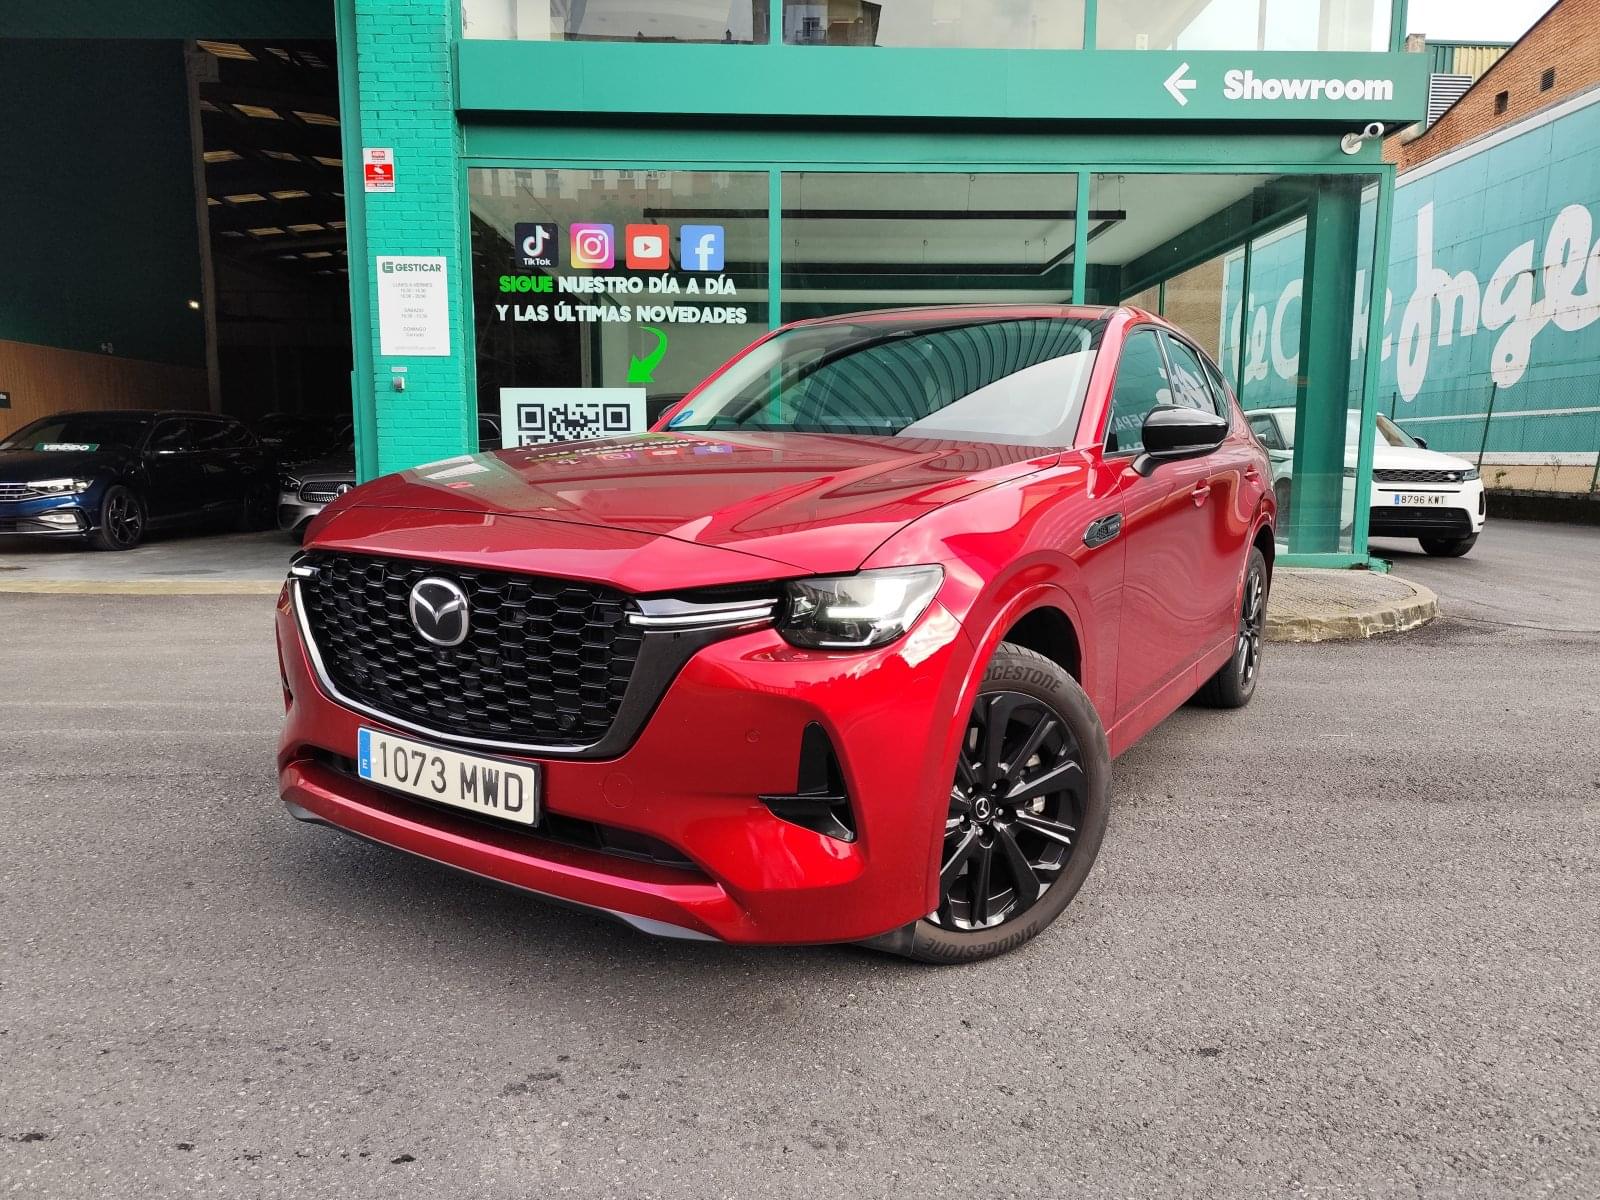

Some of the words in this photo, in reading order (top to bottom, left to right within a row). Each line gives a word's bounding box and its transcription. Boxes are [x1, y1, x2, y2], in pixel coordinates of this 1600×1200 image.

[1223, 69, 1394, 100] Showroom
[395, 263, 442, 272] GESTICAR
[523, 258, 551, 266] TikTok
[499, 275, 553, 293] SIGUE
[558, 276, 643, 293] NUESTRO
[648, 273, 680, 294] DÍA
[686, 277, 700, 294] A
[705, 274, 737, 295] DÍA
[495, 304, 509, 321] Y
[514, 304, 549, 322] LAS
[553, 301, 632, 322] ÚLTIMAS
[637, 305, 748, 324] NOVEDADES
[1401, 495, 1425, 504] 8796
[379, 741, 447, 794] 1073
[459, 761, 524, 813] MWD
